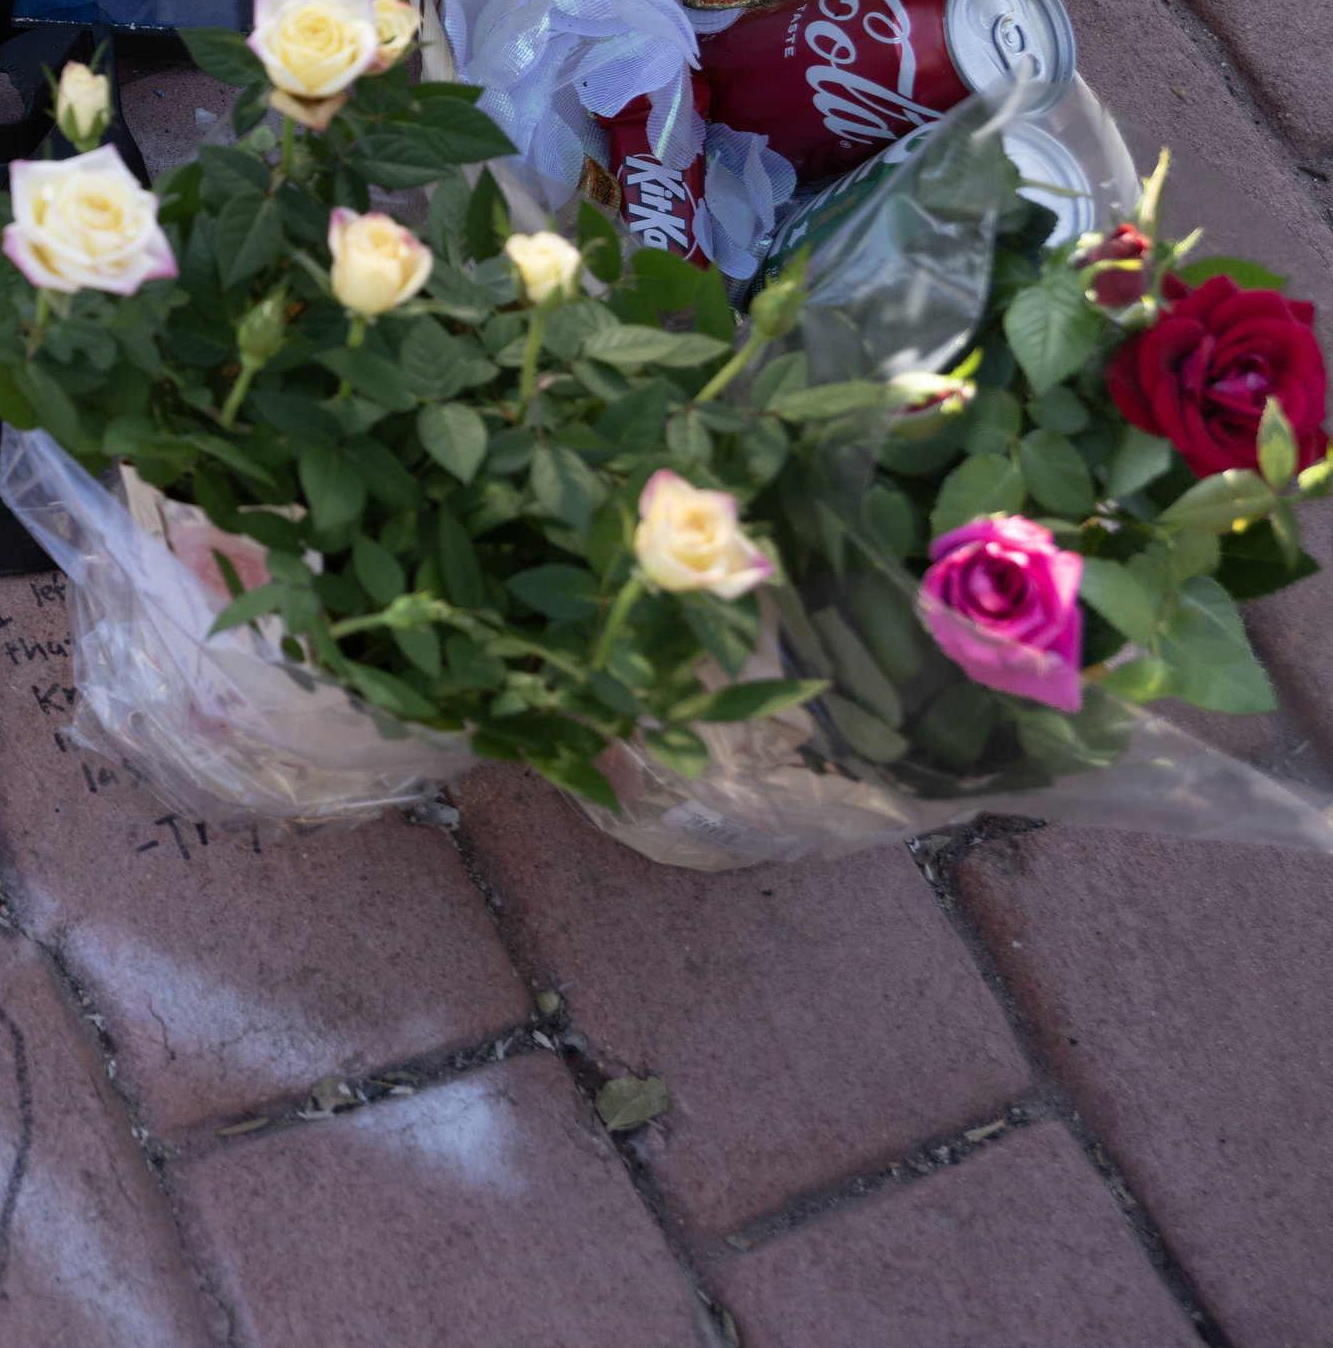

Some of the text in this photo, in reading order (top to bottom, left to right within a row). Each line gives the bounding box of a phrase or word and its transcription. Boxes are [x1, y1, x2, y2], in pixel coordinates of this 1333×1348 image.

[784, 4, 808, 59] TASTE
[625, 155, 690, 250] KitKa
[30, 573, 67, 608] lef
[4, 632, 72, 666] tha
